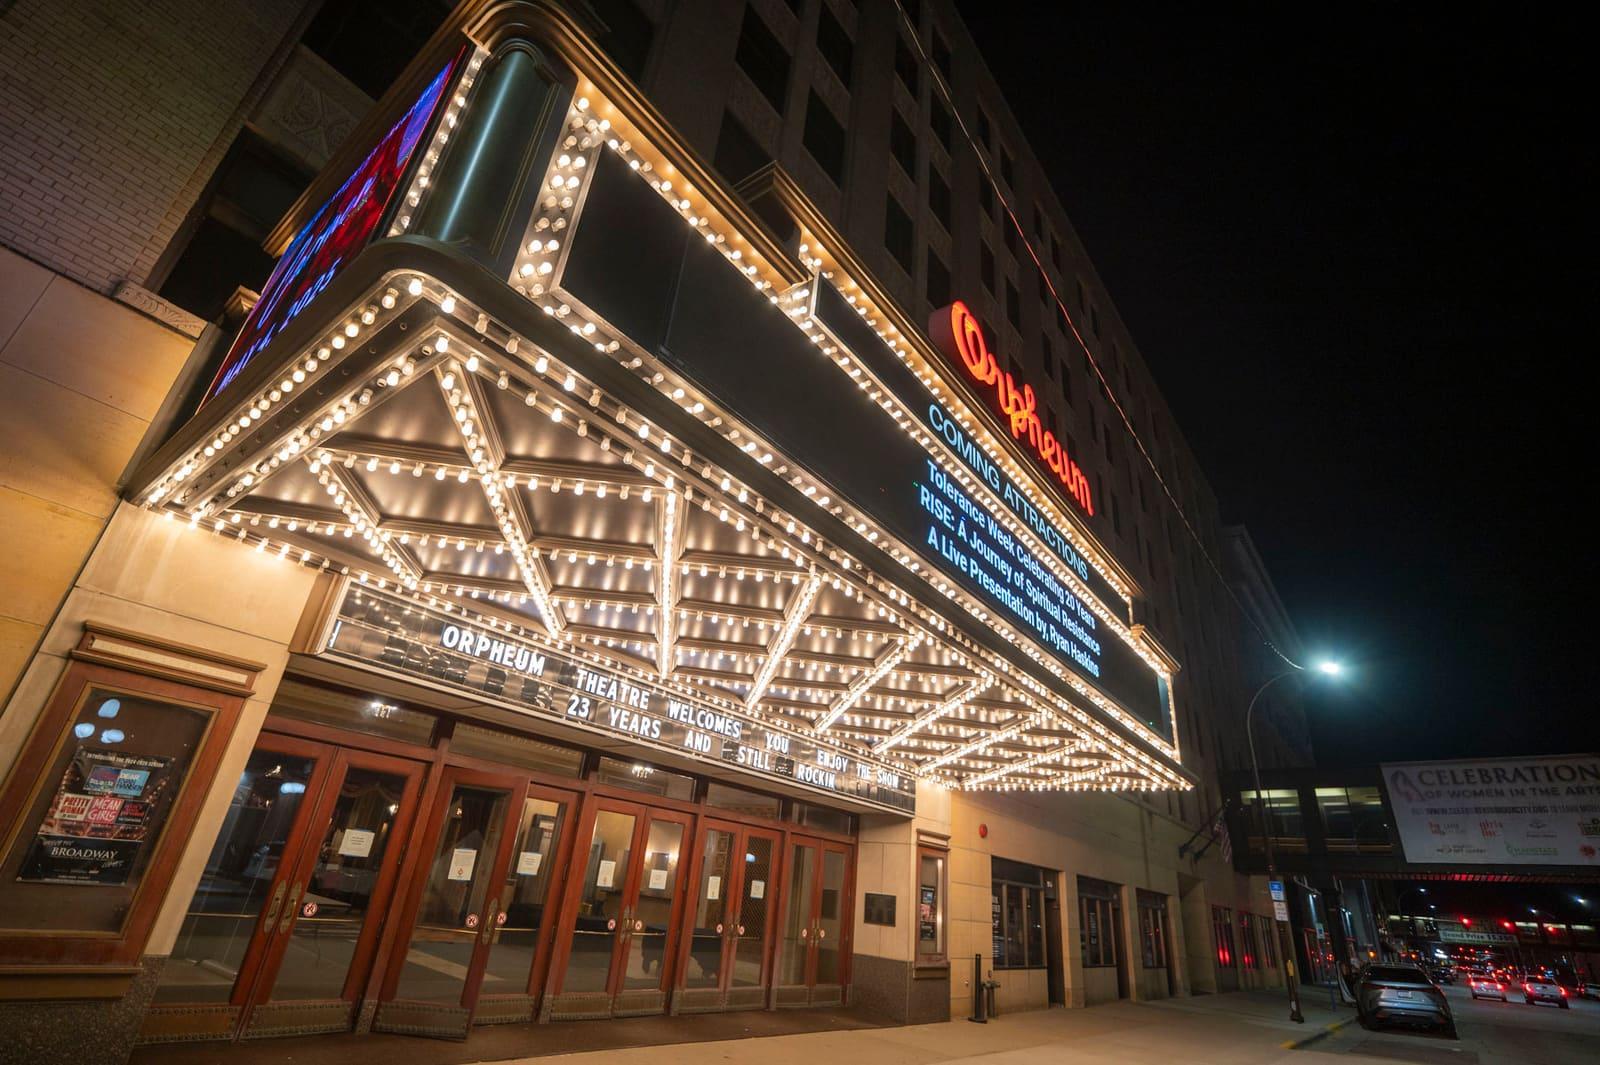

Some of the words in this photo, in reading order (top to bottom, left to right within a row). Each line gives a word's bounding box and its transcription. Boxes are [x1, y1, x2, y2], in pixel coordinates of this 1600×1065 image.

[951, 300, 1095, 517] Orpheum
[927, 460, 986, 528] Tolerance
[987, 515, 1015, 556] Week
[1017, 545, 1065, 604] Celebrating
[1065, 590, 1075, 611] 20
[1076, 600, 1096, 630] Years
[929, 404, 1000, 492] COMING
[1004, 482, 1089, 581] ATTRACTIONS
[920, 485, 955, 531] RISE:
[957, 519, 968, 543] A
[969, 531, 1013, 583] Journey
[1014, 571, 1025, 590] of
[1026, 579, 1061, 622] Spiritual
[1062, 610, 1101, 656] Resistance
[928, 526, 939, 551] A
[941, 535, 968, 573] Live
[970, 558, 1035, 627] Presentation
[1049, 623, 1070, 653] Ryan
[1070, 641, 1100, 678] Haskins
[442, 626, 546, 677] ORPHEUM
[576, 669, 651, 711] THEATRE
[668, 699, 742, 739] WELCOMES
[766, 733, 790, 755] YOU
[816, 748, 848, 773] ENJOY
[856, 763, 871, 780] THE
[877, 769, 899, 789] SHOW
[567, 695, 590, 719] 23
[609, 706, 662, 740] YEARS
[684, 730, 712, 753] AND
[737, 746, 770, 771] STILL
[797, 764, 836, 790] ROCKIN
[88, 809, 117, 821] GIRLS
[92, 798, 122, 811] MEAN
[1417, 763, 1600, 786] CELEBRATION
[1425, 790, 1442, 799] OF
[1450, 788, 1505, 799] WOMEN
[1509, 788, 1526, 797] IN
[1531, 787, 1560, 796] THE
[51, 847, 118, 859] BROADWAY
